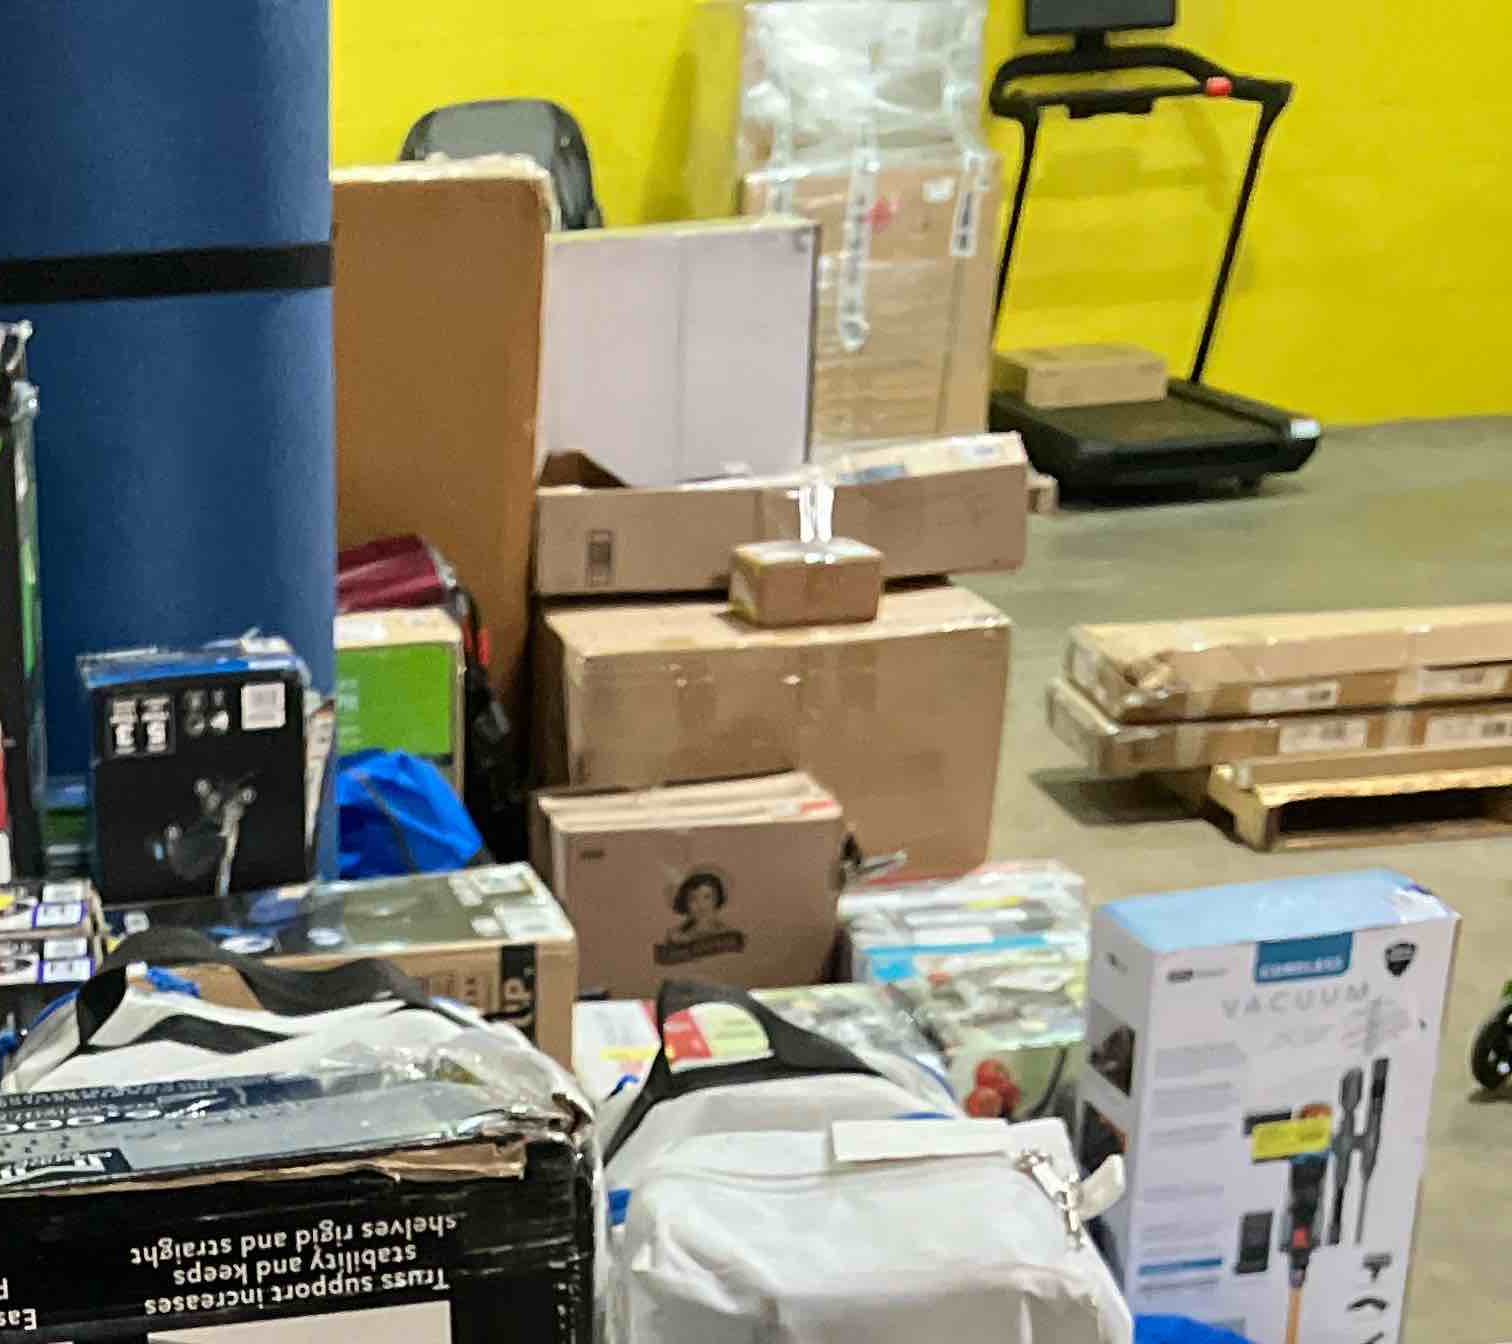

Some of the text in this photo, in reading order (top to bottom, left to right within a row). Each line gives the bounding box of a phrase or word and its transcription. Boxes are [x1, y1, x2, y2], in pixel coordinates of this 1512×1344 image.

[1220, 982, 1369, 1019] VACUUM
[130, 1215, 457, 1269] shelves rigid and straight
[173, 1244, 416, 1285] stability and keeps
[144, 1268, 450, 1315] Truss support increases
